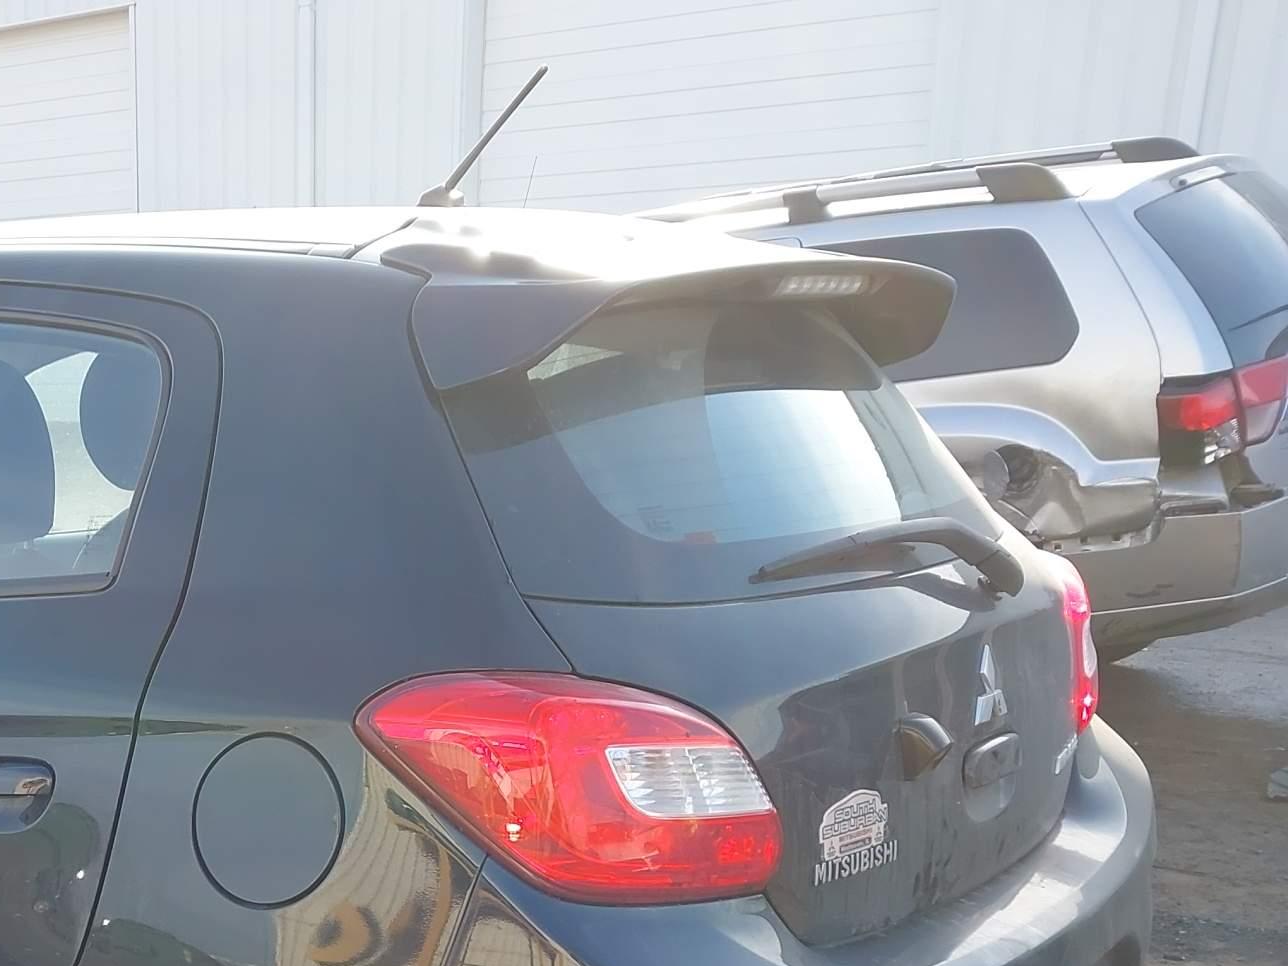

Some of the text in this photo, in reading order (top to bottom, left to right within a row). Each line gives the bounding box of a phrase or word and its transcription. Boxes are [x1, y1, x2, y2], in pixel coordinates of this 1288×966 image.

[822, 807, 888, 841] SUBURBAN
[833, 798, 877, 824] SOUTH
[814, 839, 898, 887] MITSUBISHI
